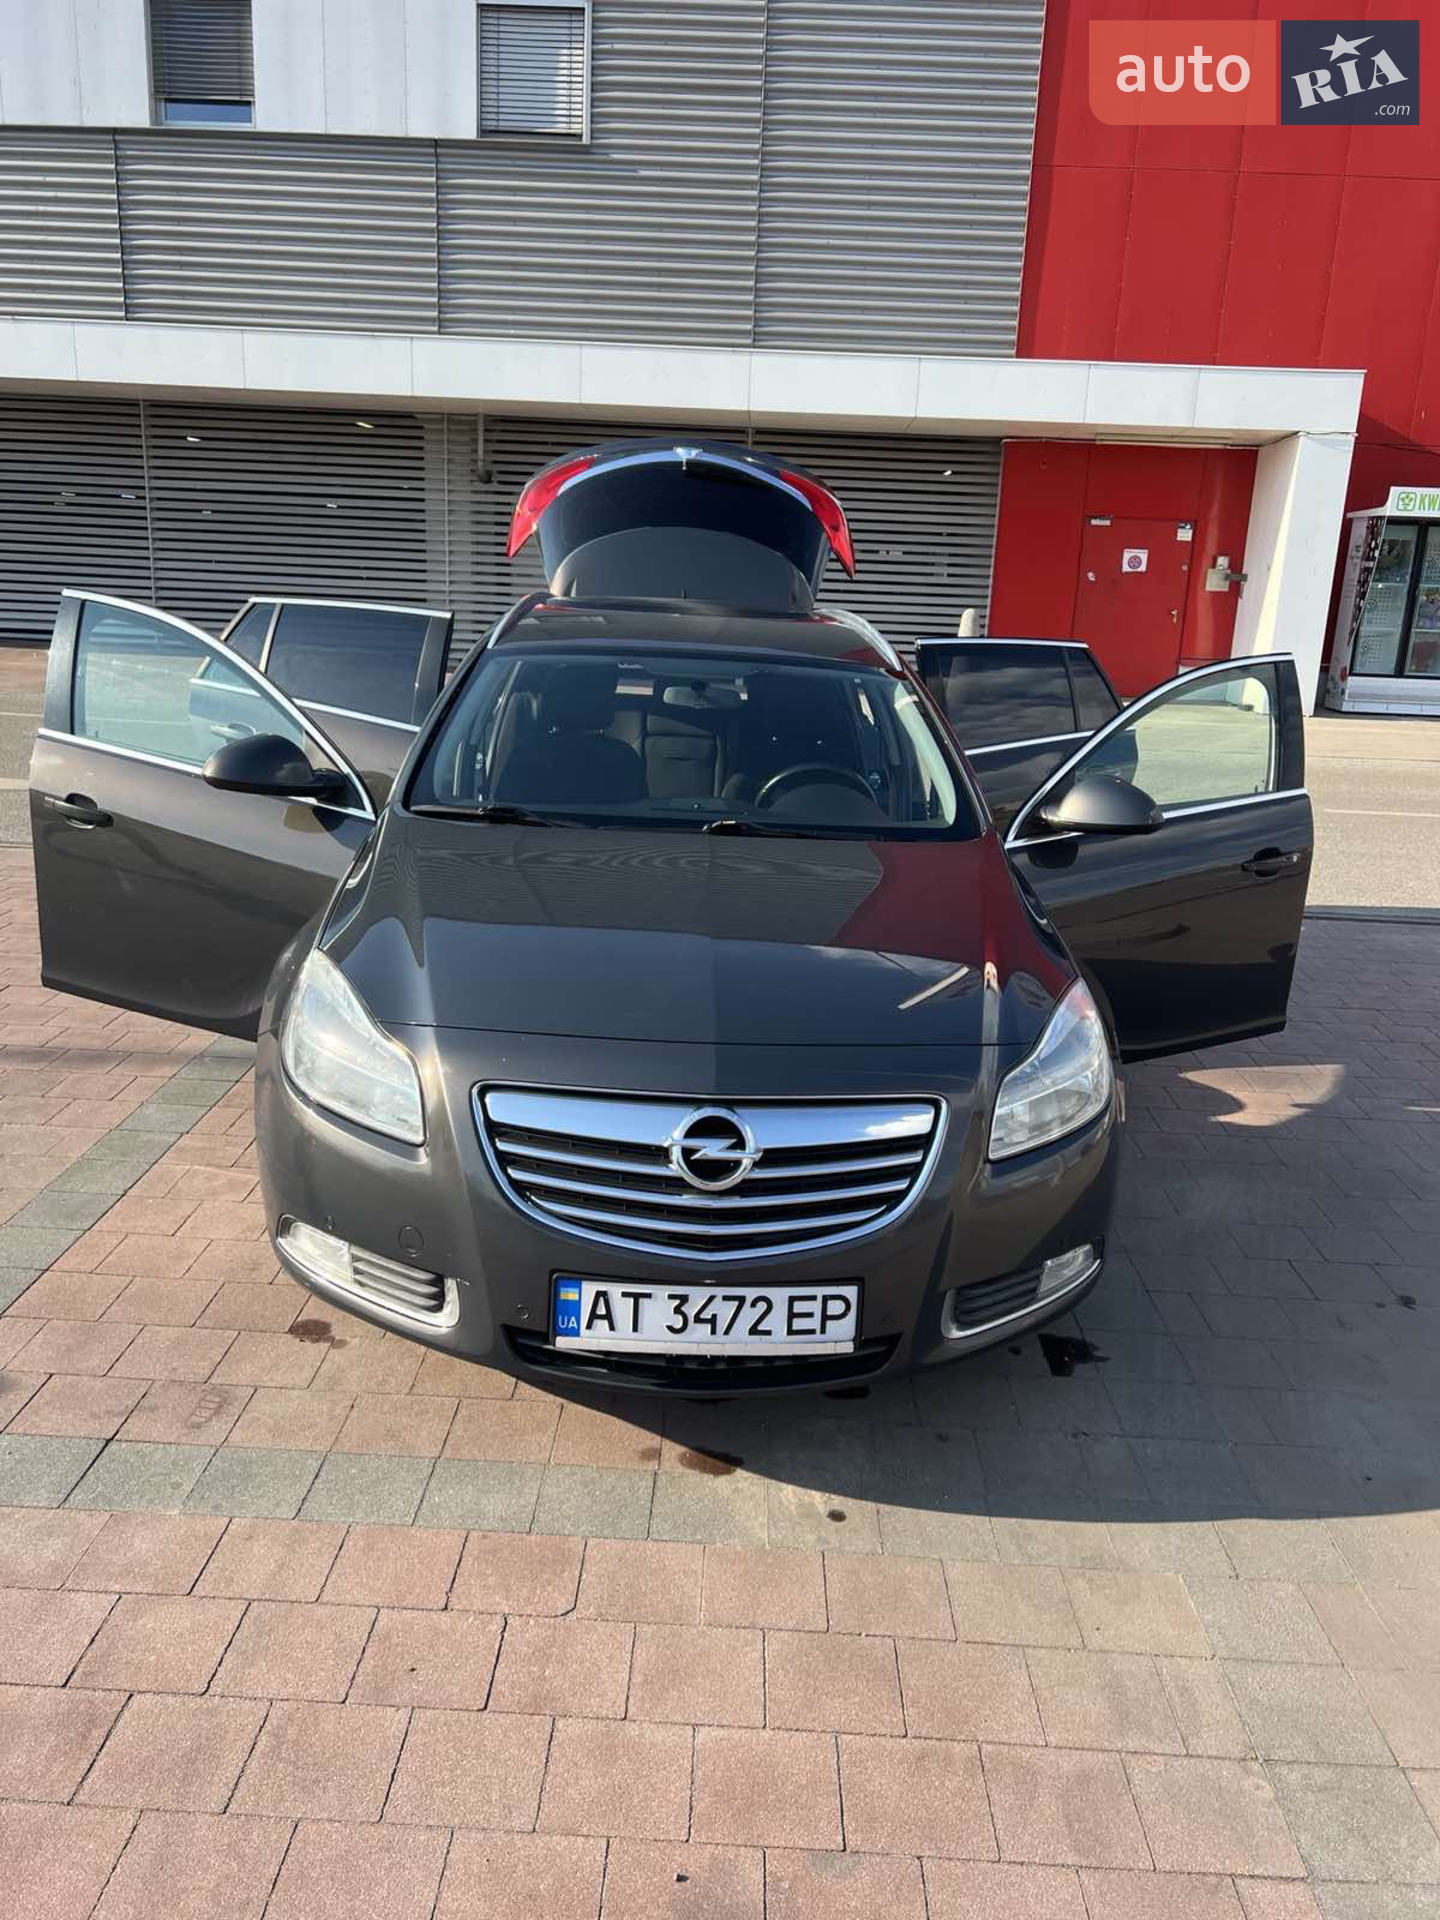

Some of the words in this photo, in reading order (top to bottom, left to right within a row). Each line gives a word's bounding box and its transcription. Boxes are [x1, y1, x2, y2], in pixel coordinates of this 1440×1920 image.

[558, 1315, 577, 1329] UA
[586, 1290, 652, 1332] AT
[665, 1294, 773, 1336] 3472
[786, 1294, 851, 1335] EP
